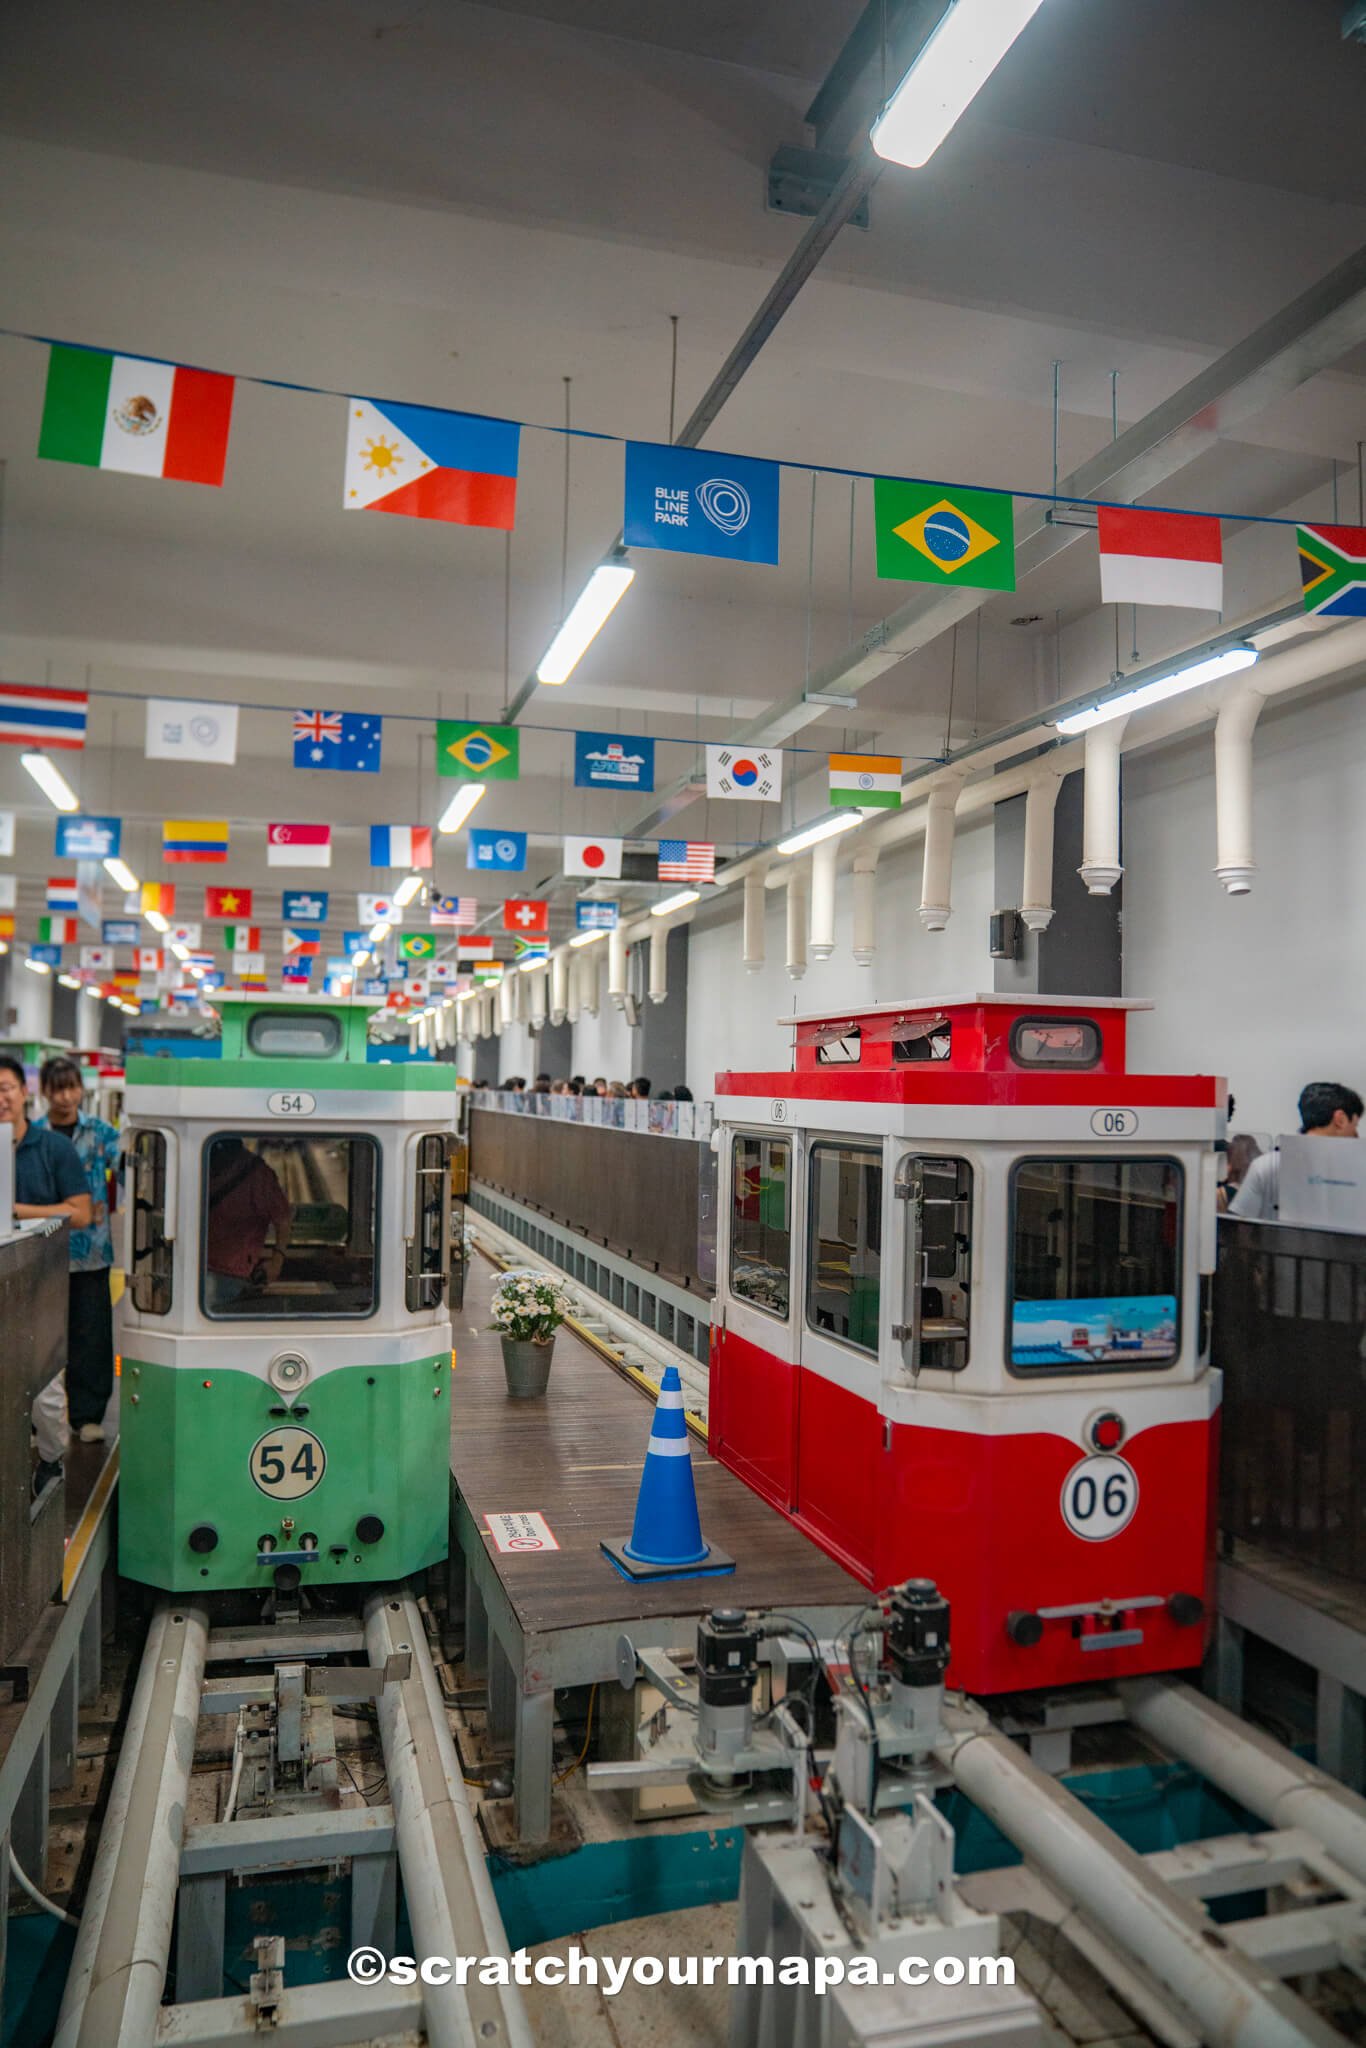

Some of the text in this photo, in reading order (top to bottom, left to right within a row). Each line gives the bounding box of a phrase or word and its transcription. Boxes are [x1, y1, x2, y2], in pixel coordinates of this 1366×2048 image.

[655, 487, 689, 502] BLUE
[655, 499, 689, 515] LINE
[654, 512, 689, 527] PARK
[281, 1095, 302, 1112] 54
[774, 1103, 783, 1119] 06
[1104, 1113, 1125, 1132] 06
[259, 1443, 317, 1485] 54
[1072, 1473, 1127, 1520] 06
